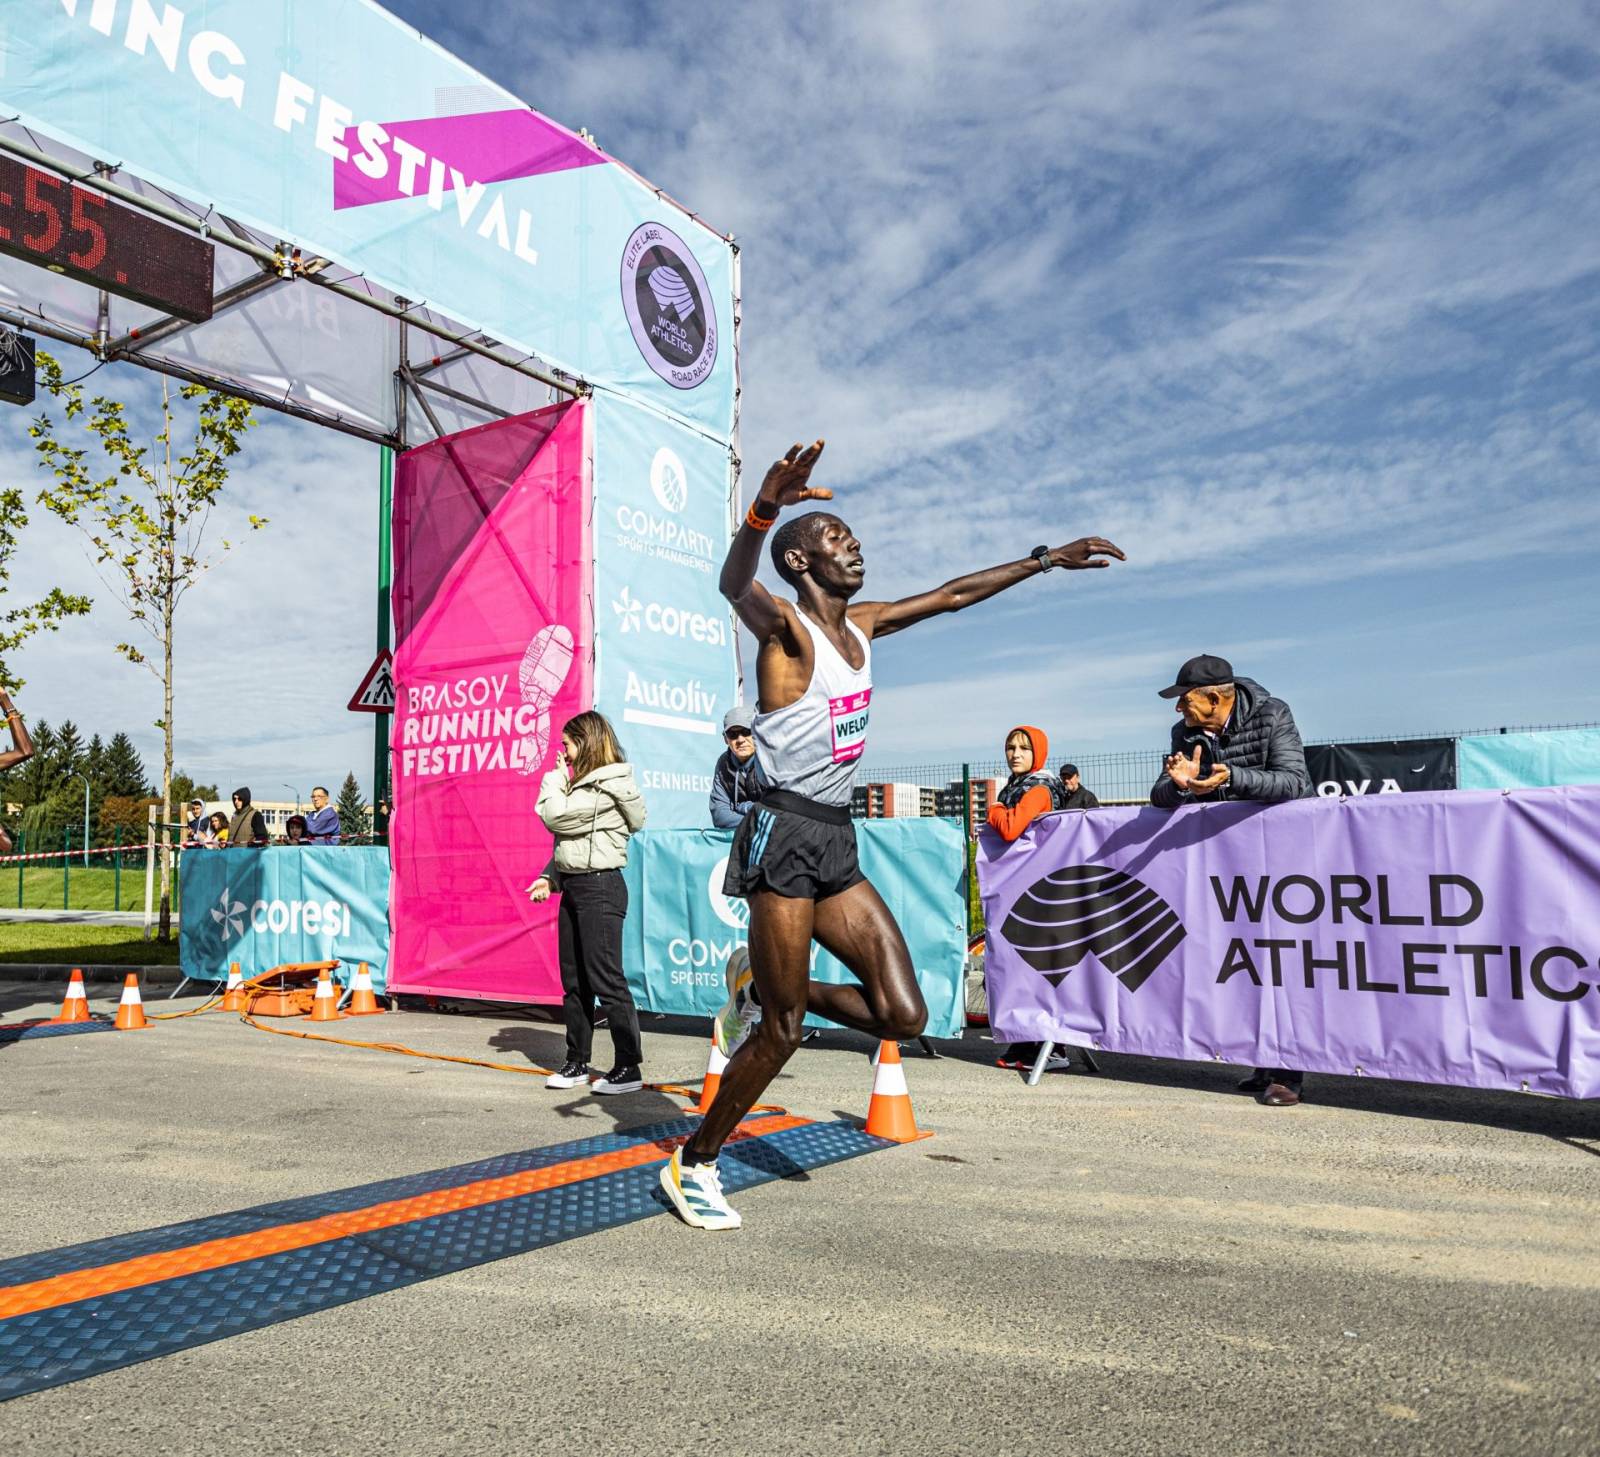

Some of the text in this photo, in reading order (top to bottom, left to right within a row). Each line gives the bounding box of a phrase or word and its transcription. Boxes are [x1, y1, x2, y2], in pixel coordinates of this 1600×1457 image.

[61, 0, 538, 265] ING FESTIVAL
[626, 229, 663, 269] ELITE LABEL
[651, 325, 693, 355] ATHLETICS
[657, 315, 687, 339] WORLD
[671, 369, 693, 381] ROAD
[692, 356, 709, 379] RACE
[616, 505, 714, 560] COMPARTY
[616, 533, 656, 557] SPORTS
[645, 602, 726, 646] coresi
[408, 674, 509, 714] BRASOV
[624, 671, 717, 716] Autoliv
[403, 704, 537, 745] RUNNING
[402, 739, 527, 777] FESTIVAL
[643, 770, 711, 793] SENNHEIS
[251, 899, 351, 937] coresi
[1209, 874, 1483, 927] WORLD
[671, 970, 719, 987] SPORTS
[1216, 937, 1600, 1002] ATHLETIC
